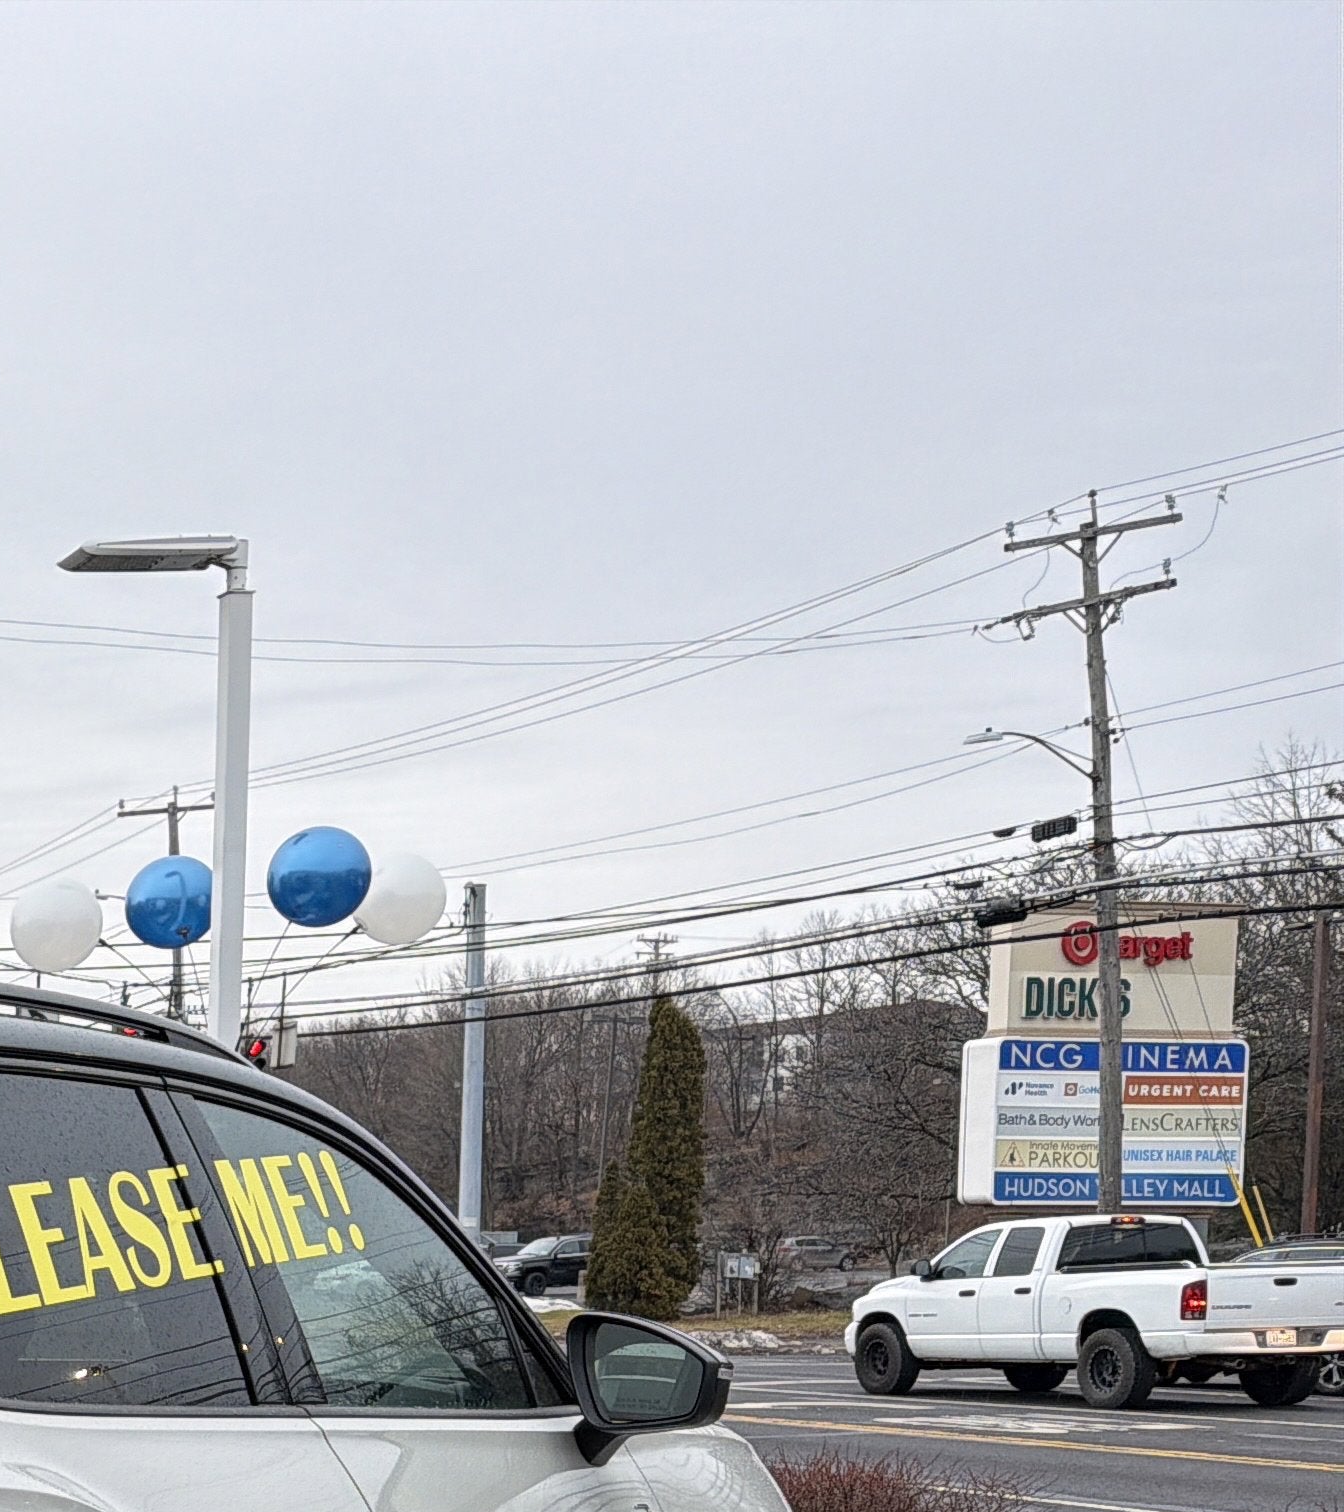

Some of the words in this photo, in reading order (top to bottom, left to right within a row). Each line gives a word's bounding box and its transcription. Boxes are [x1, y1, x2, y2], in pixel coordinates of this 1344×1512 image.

[1119, 931, 1194, 967] arget
[1025, 976, 1132, 1018] DICKS
[1010, 1043, 1083, 1069] NCG
[1126, 1045, 1233, 1070] INEMA
[1128, 1084, 1193, 1097] URGENT
[1198, 1085, 1241, 1098] CARE
[998, 1113, 1028, 1126] Bath
[1039, 1114, 1071, 1129] Body
[1073, 1115, 1101, 1127] Wor
[1028, 1151, 1100, 1169] PARKOU
[1123, 1149, 1163, 1161] UNISEX
[1166, 1149, 1193, 1161] HAIR
[1195, 1149, 1238, 1162] PALACE
[1004, 1178, 1089, 1198] HUDSON
[1095, 1178, 1169, 1198] LLEY
[1173, 1180, 1226, 1198] MALL
[214, 1150, 365, 1268] ME!!
